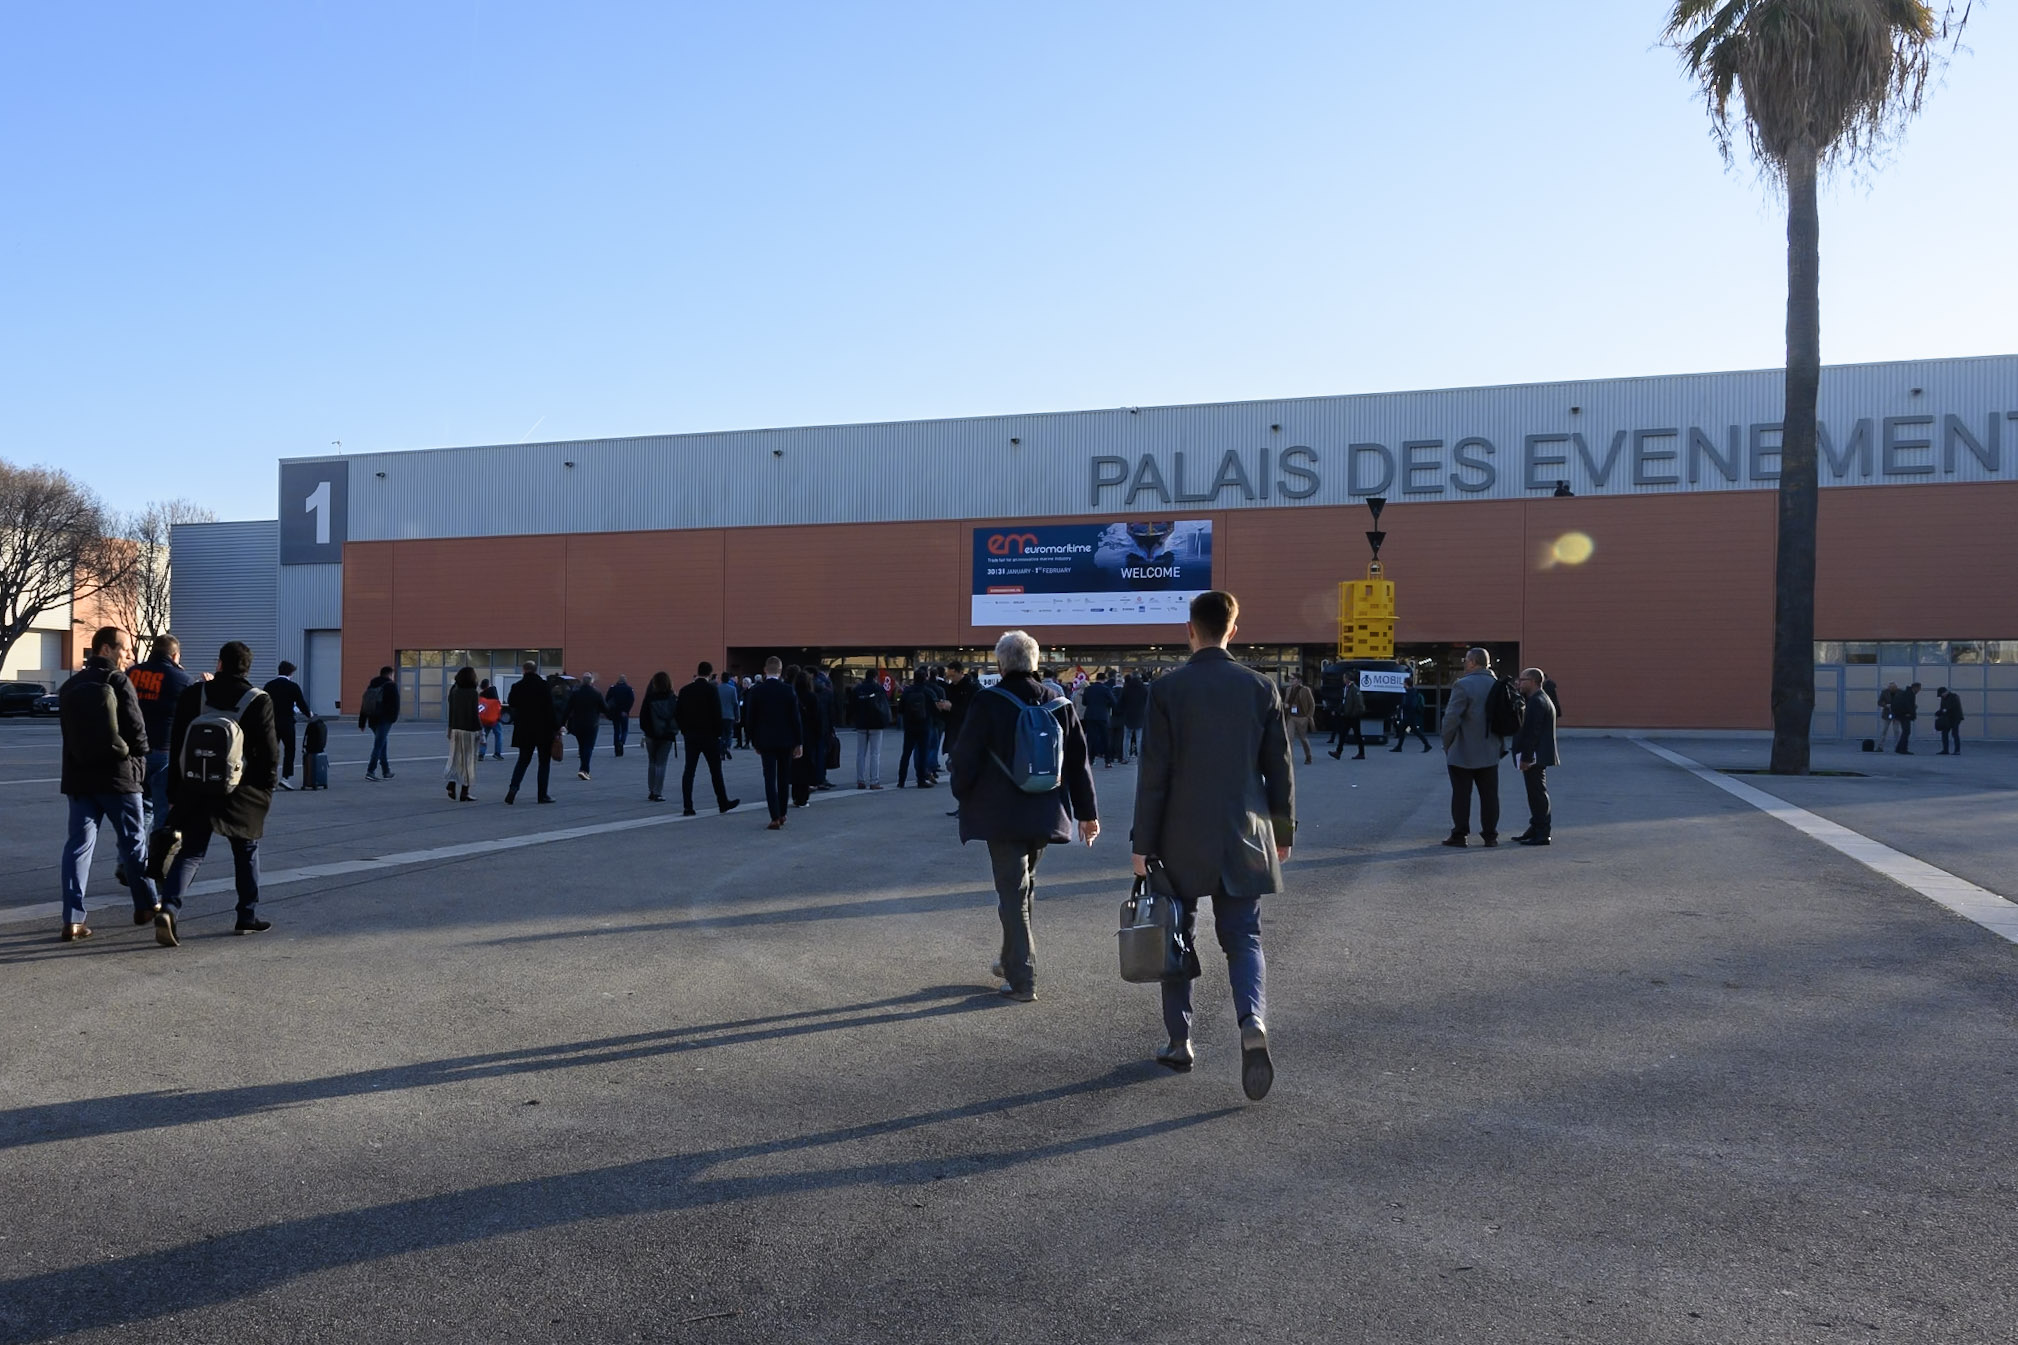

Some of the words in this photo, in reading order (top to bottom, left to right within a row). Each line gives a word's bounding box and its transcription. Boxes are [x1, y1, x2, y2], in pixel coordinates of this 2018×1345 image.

[1090, 446, 1321, 506] PALAIS
[1348, 436, 1497, 497] DES
[1524, 411, 2018, 491] EVENEMEN
[305, 481, 331, 544] 1
[1024, 543, 1092, 554] euromaritime
[1042, 566, 1072, 574] FEBRUARY
[1120, 566, 1181, 579] WELCOME
[1373, 675, 1404, 684] MOBIL
